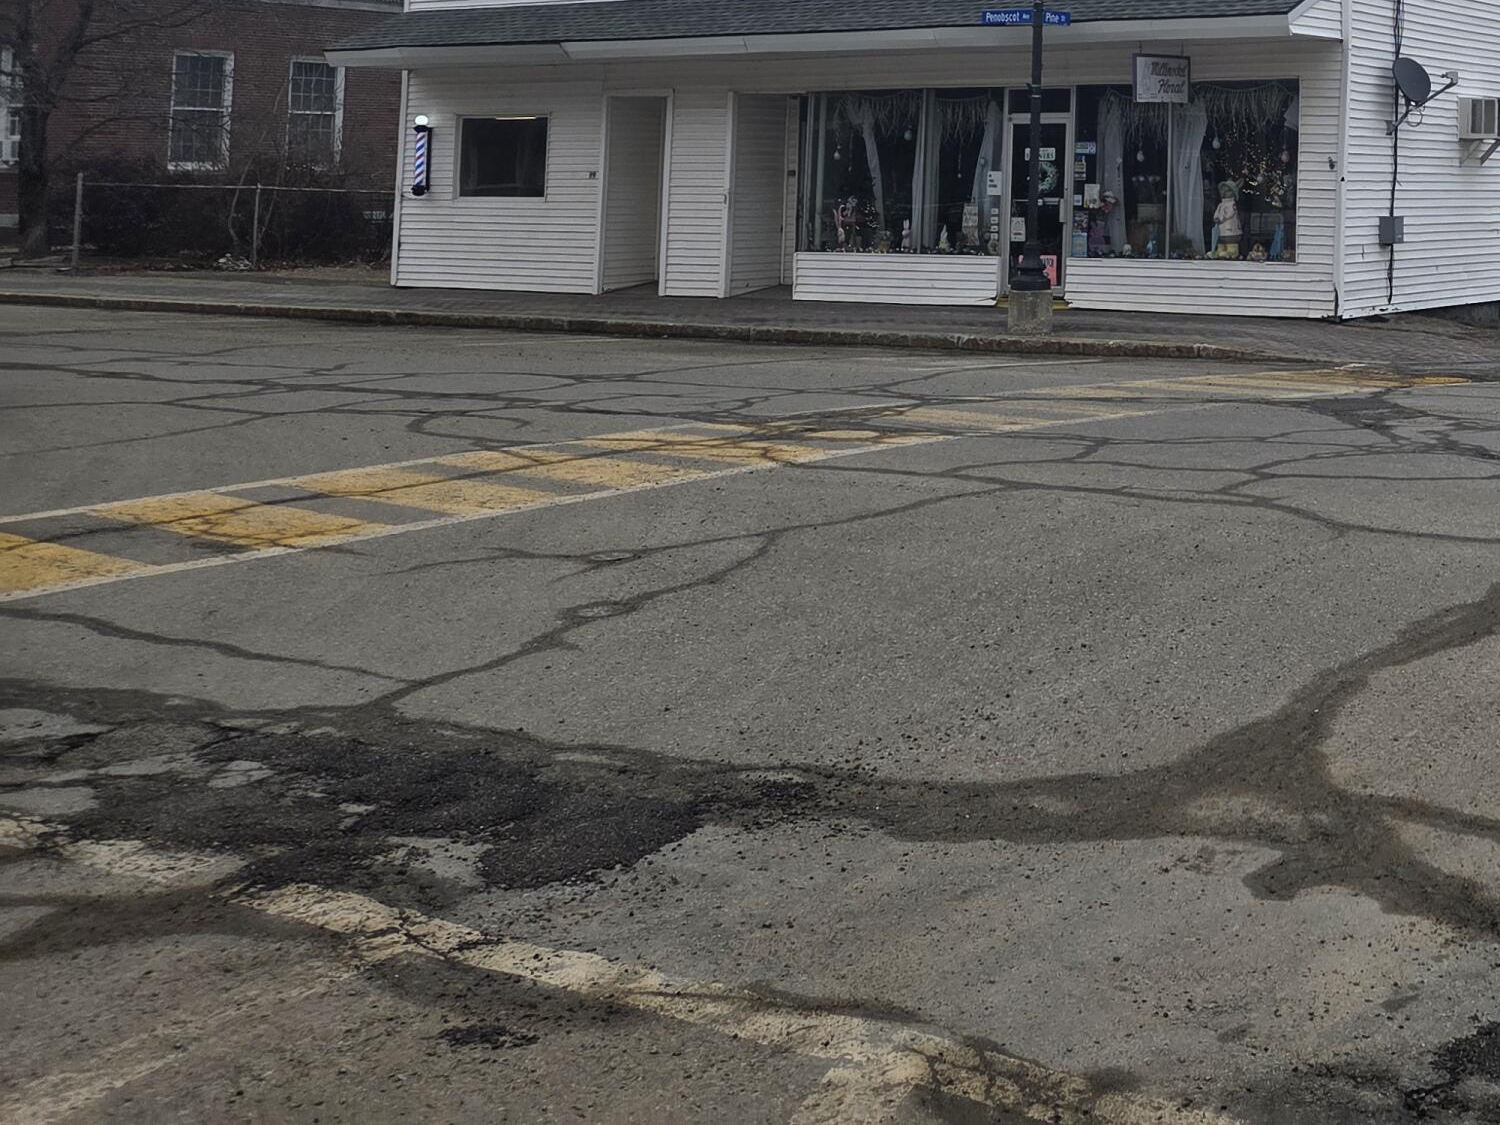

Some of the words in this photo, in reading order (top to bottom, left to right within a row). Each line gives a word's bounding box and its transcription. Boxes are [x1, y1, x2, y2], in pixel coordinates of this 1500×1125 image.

[985, 12, 1020, 22] Penobscot
[1045, 12, 1059, 23] Pine
[1158, 79, 1185, 94] Floral
